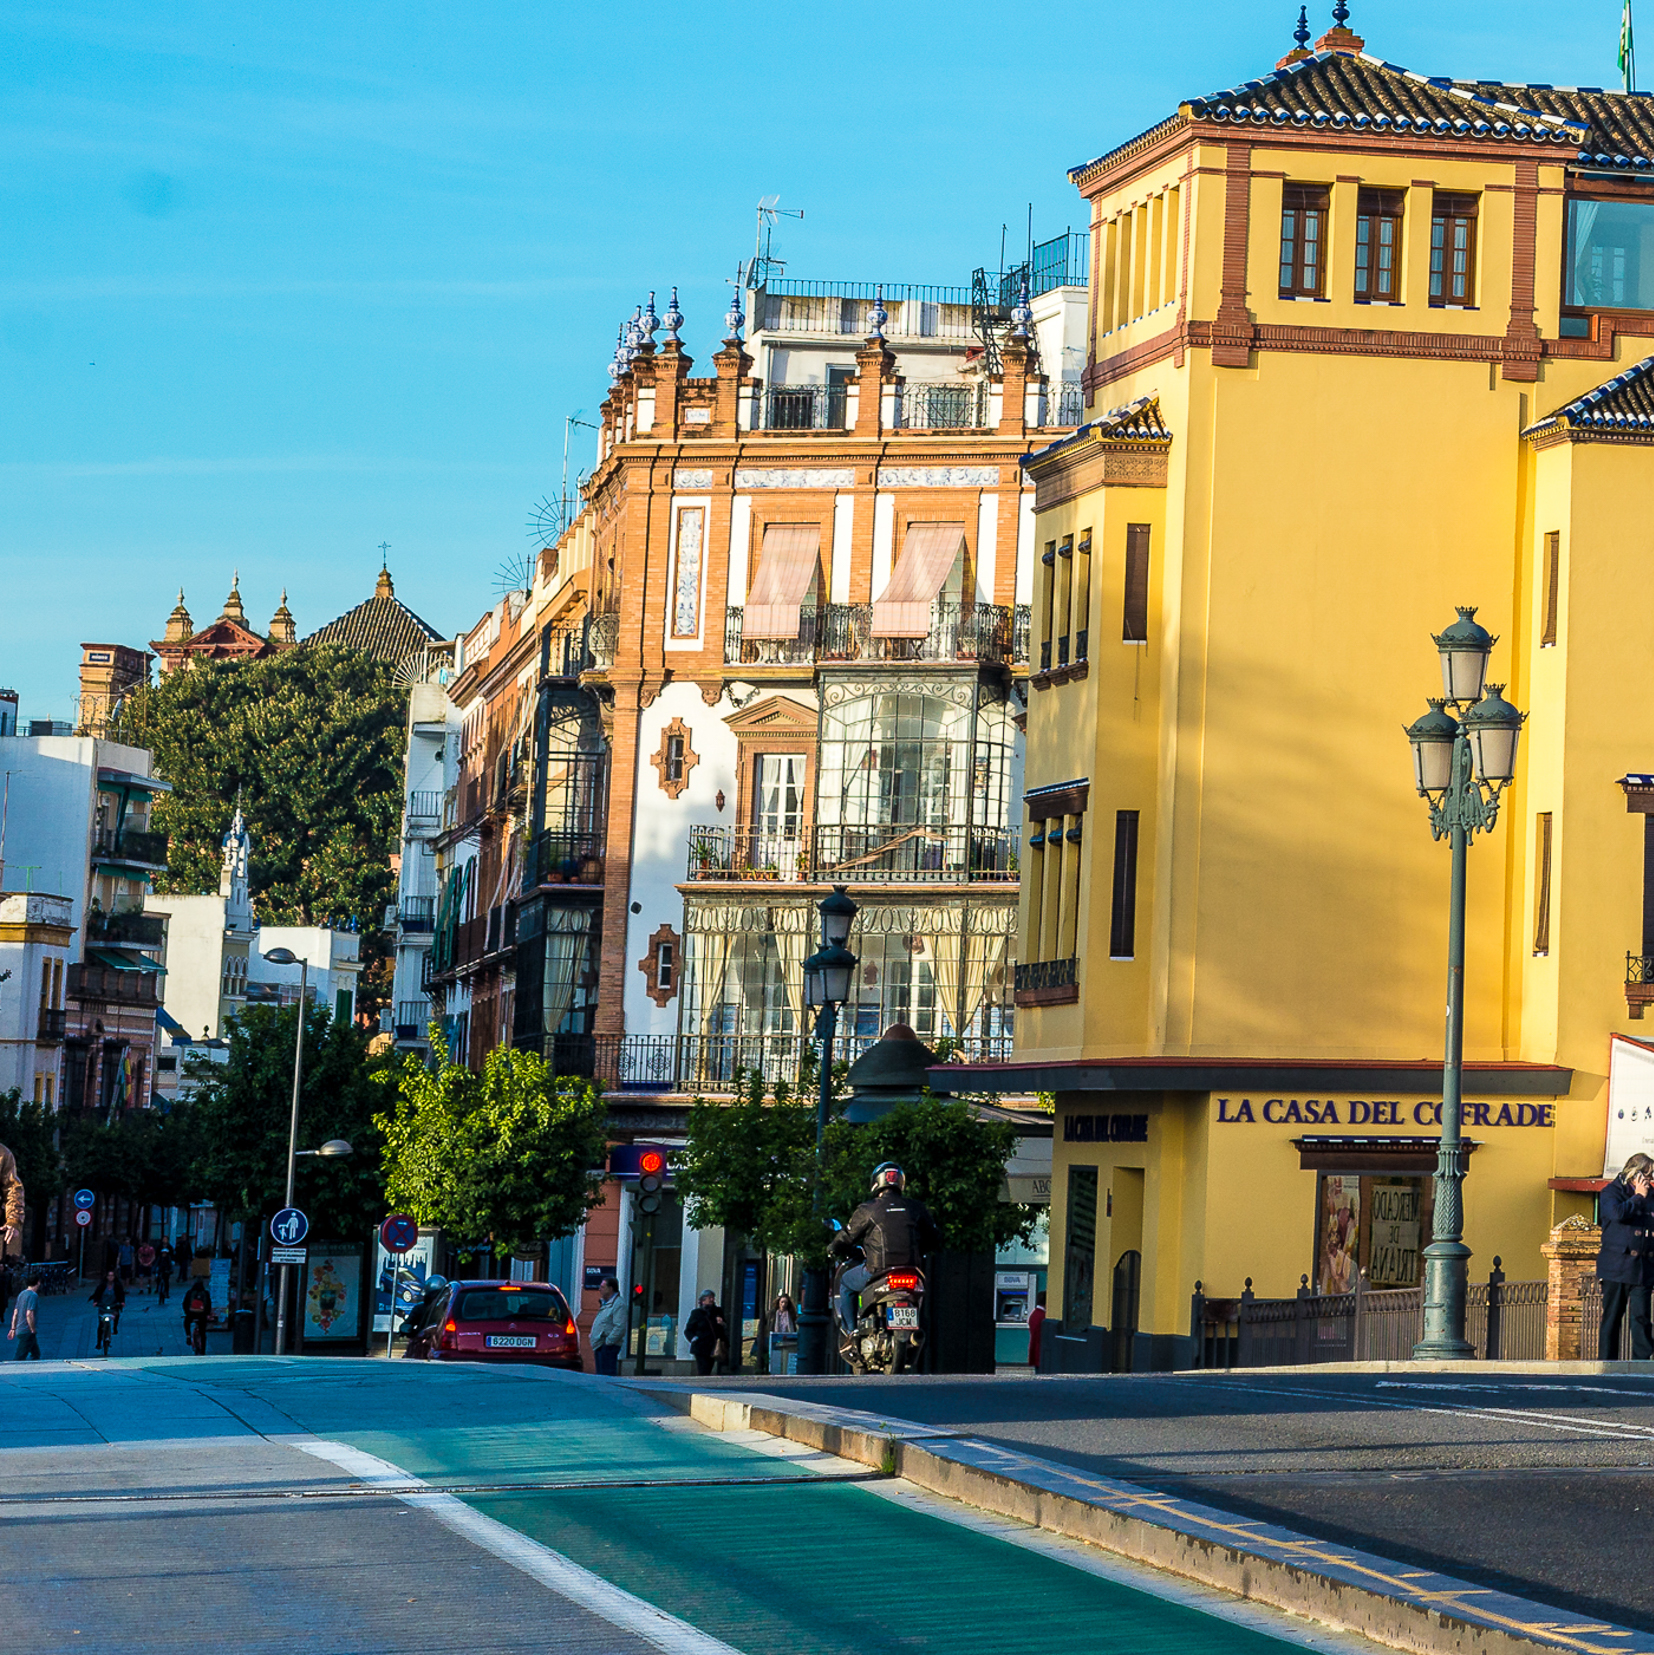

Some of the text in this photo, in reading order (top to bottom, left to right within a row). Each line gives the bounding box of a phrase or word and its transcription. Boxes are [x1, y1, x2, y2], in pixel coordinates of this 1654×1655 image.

[1216, 1099, 1256, 1123] LA
[1262, 1099, 1341, 1125] CASA
[1347, 1100, 1406, 1126] DEL
[894, 1308, 916, 1318] 8168
